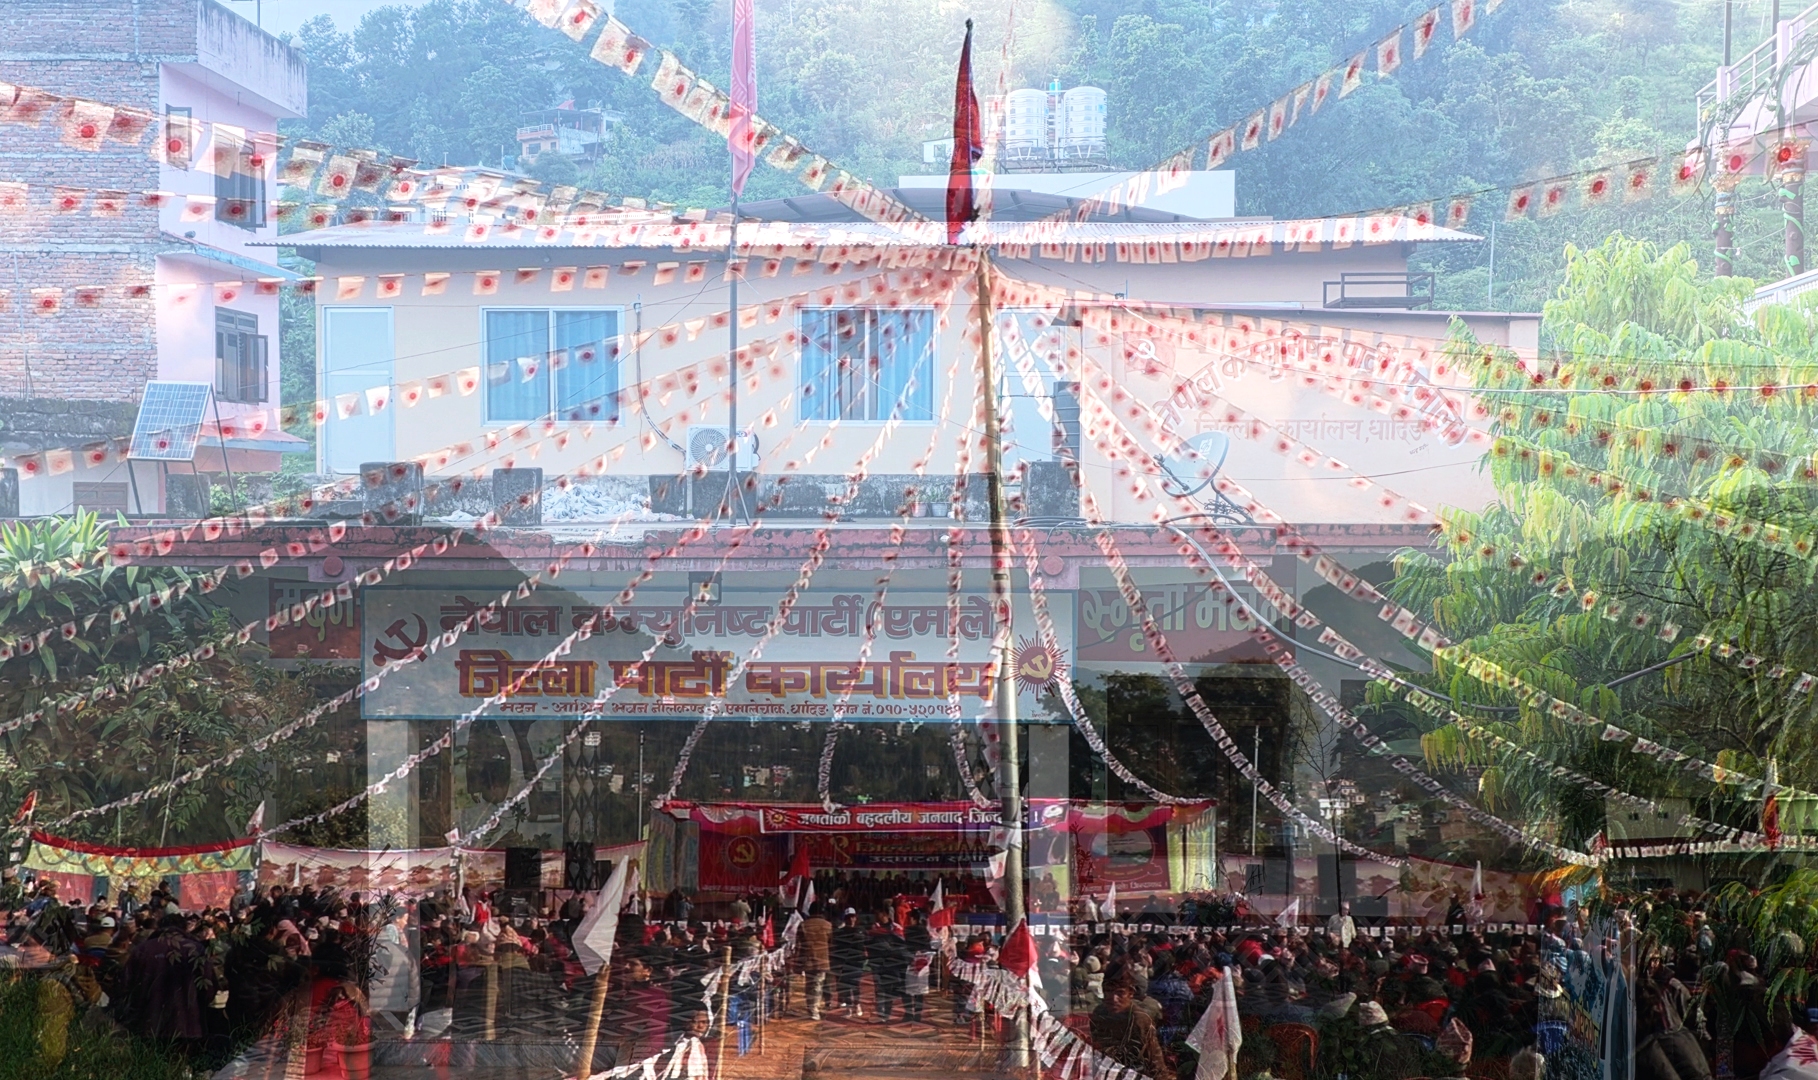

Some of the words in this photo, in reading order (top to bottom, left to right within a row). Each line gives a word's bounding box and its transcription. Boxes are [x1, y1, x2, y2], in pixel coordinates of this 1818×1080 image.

[1153, 361, 1221, 433] नेपाल
[440, 595, 562, 636] नेपाल
[781, 594, 863, 638] पार्टी
[454, 649, 598, 697] जिल्ला
[608, 650, 734, 698] पार्टी
[745, 650, 996, 699] कार्यालय
[612, 702, 648, 715] भवन
[797, 809, 851, 825] जनताको
